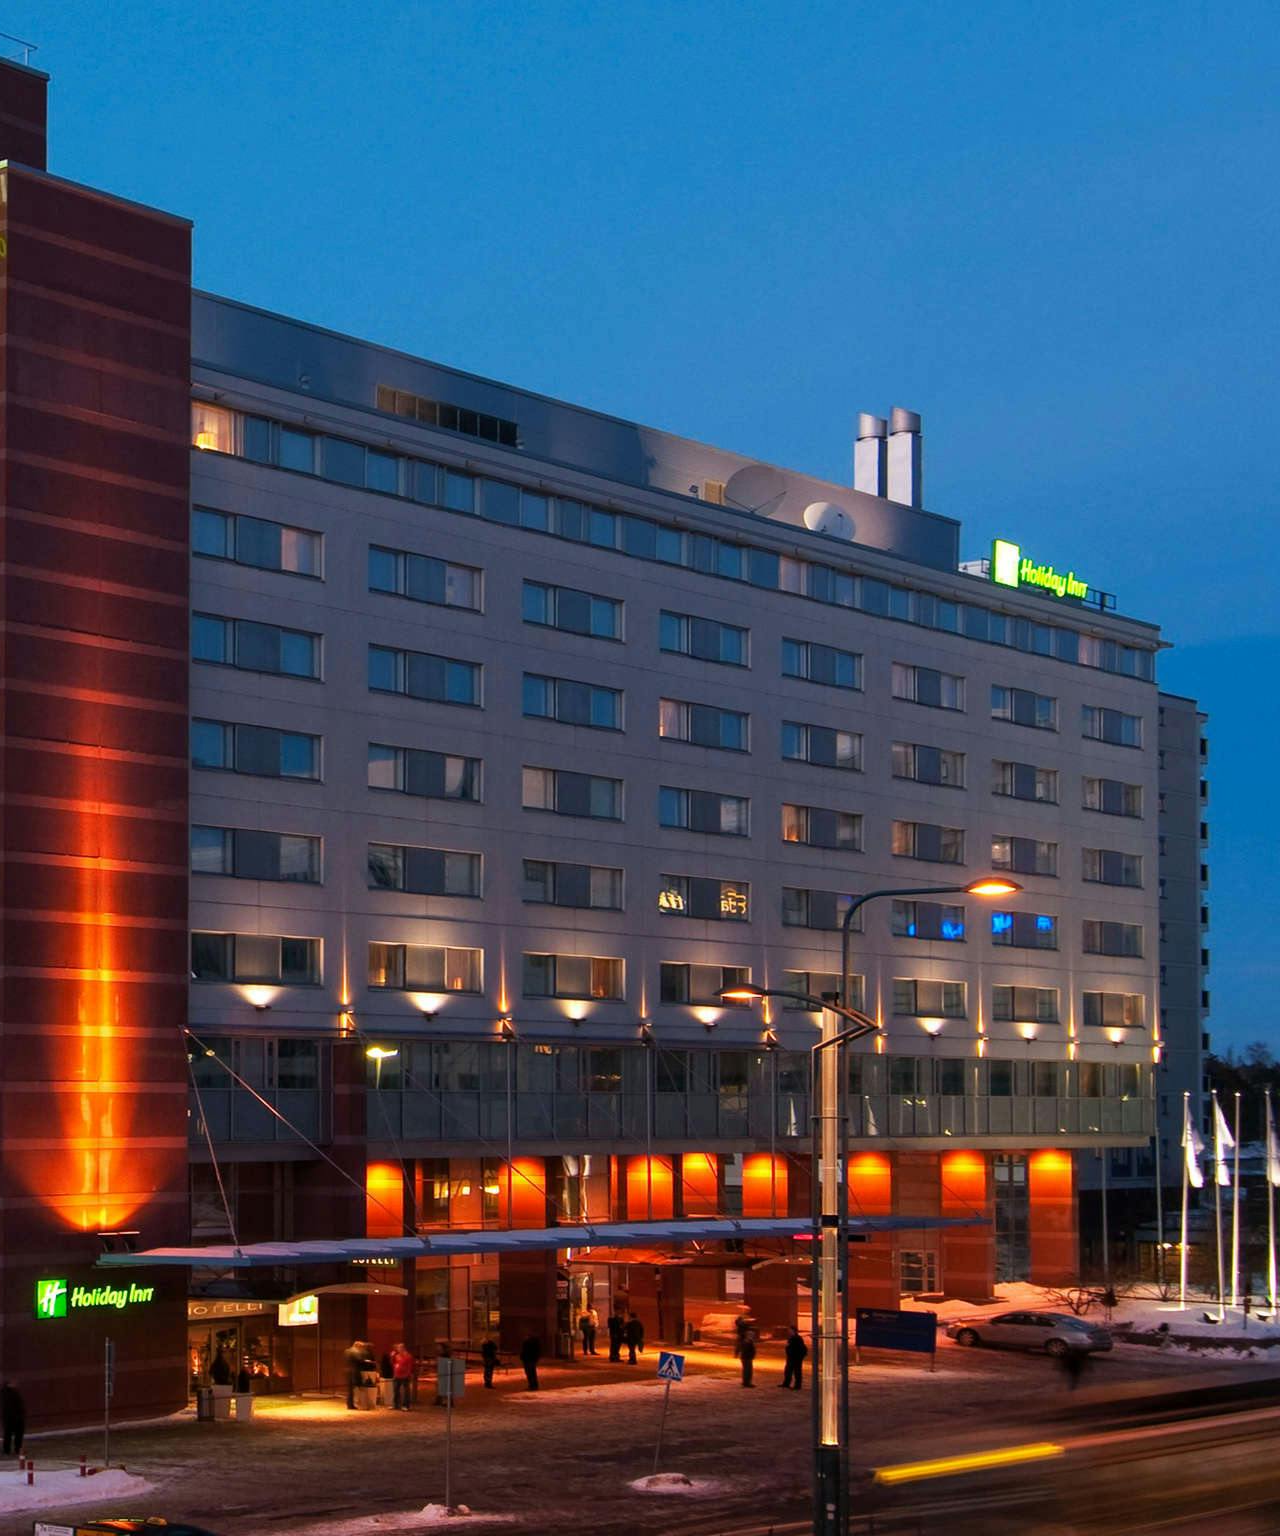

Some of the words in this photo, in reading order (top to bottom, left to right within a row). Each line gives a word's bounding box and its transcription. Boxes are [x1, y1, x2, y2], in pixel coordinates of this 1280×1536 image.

[1020, 558, 1067, 597] Holiday
[1067, 571, 1088, 598] Inn
[71, 1286, 128, 1309] Holiday
[129, 1283, 154, 1303] Inn
